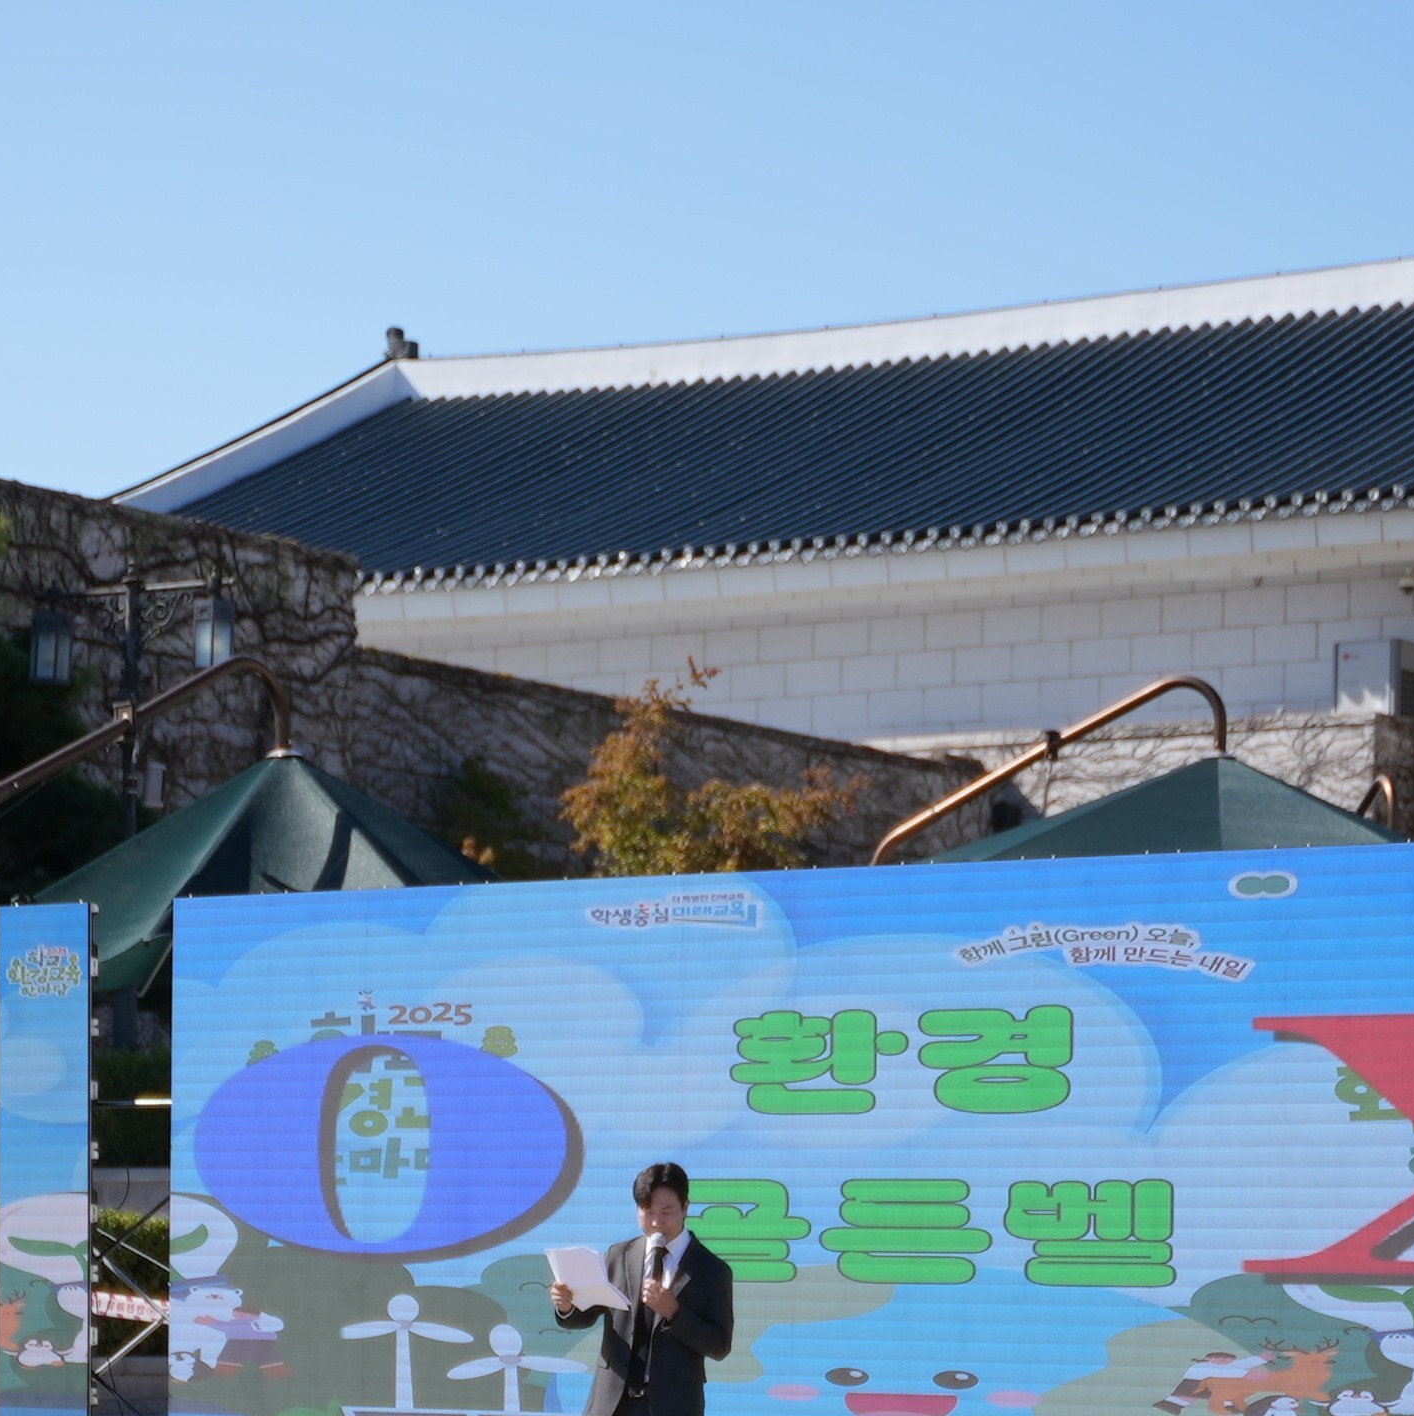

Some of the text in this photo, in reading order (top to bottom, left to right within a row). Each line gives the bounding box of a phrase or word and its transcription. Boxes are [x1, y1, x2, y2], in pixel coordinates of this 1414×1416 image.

[590, 901, 745, 927] 학생중심 미래교육
[958, 940, 1006, 963] 함께
[1069, 946, 1248, 979] 함께 만드는 내일
[387, 1002, 473, 1026] 2025
[729, 1004, 1074, 1115] 환경
